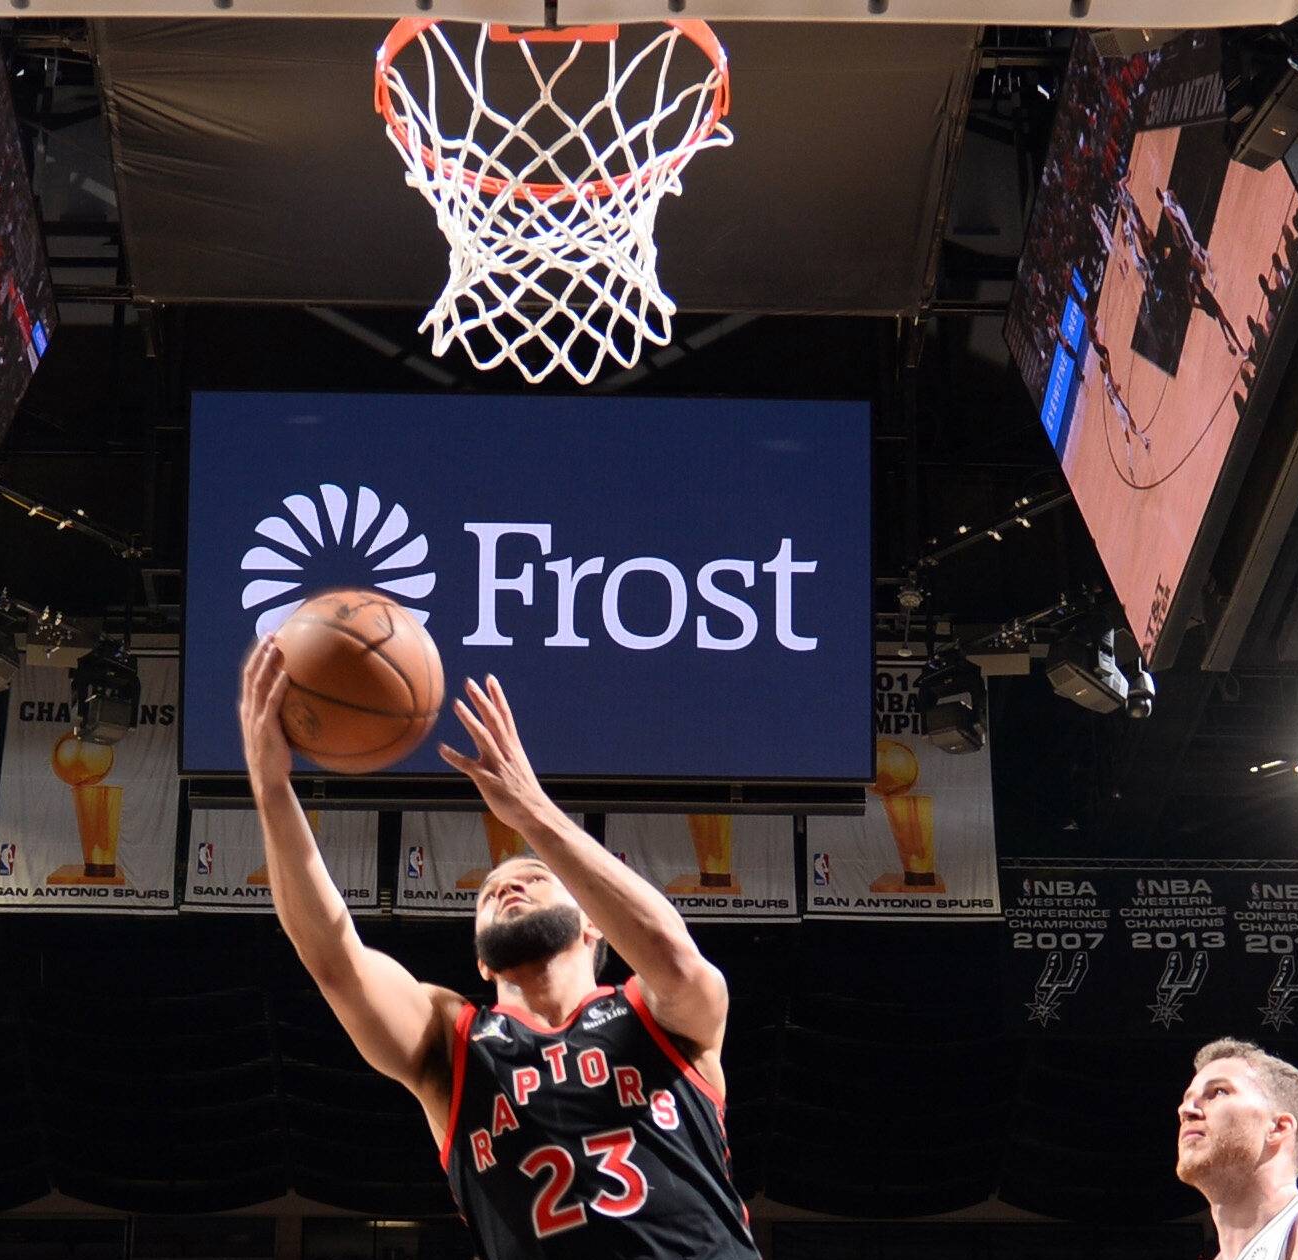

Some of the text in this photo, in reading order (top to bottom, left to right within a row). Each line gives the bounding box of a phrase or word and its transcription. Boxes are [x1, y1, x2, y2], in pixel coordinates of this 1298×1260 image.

[462, 522, 818, 652] Frost
[193, 886, 229, 897] SAN
[1034, 881, 1098, 896] NBA
[1148, 880, 1213, 895] NBA
[33, 888, 109, 898] ANTONIO
[114, 888, 169, 899] SPURS
[403, 890, 439, 900] SAN
[665, 897, 789, 909] NTONIO SPURS
[813, 896, 994, 910] SAN ANTONIO SPURS
[1017, 898, 1097, 907] WESTERN
[1131, 896, 1211, 906] WESTERN
[1005, 908, 1111, 918] CONFERENCE
[1120, 906, 1227, 917] CONFERENCE
[1008, 919, 1107, 929] CHAMPIONS
[1124, 918, 1225, 929] CHAMPIONS
[1013, 932, 1104, 950] 2007
[1131, 932, 1226, 949] 2013
[470, 1042, 681, 1174] RAPTORS
[519, 1127, 648, 1239] 23
